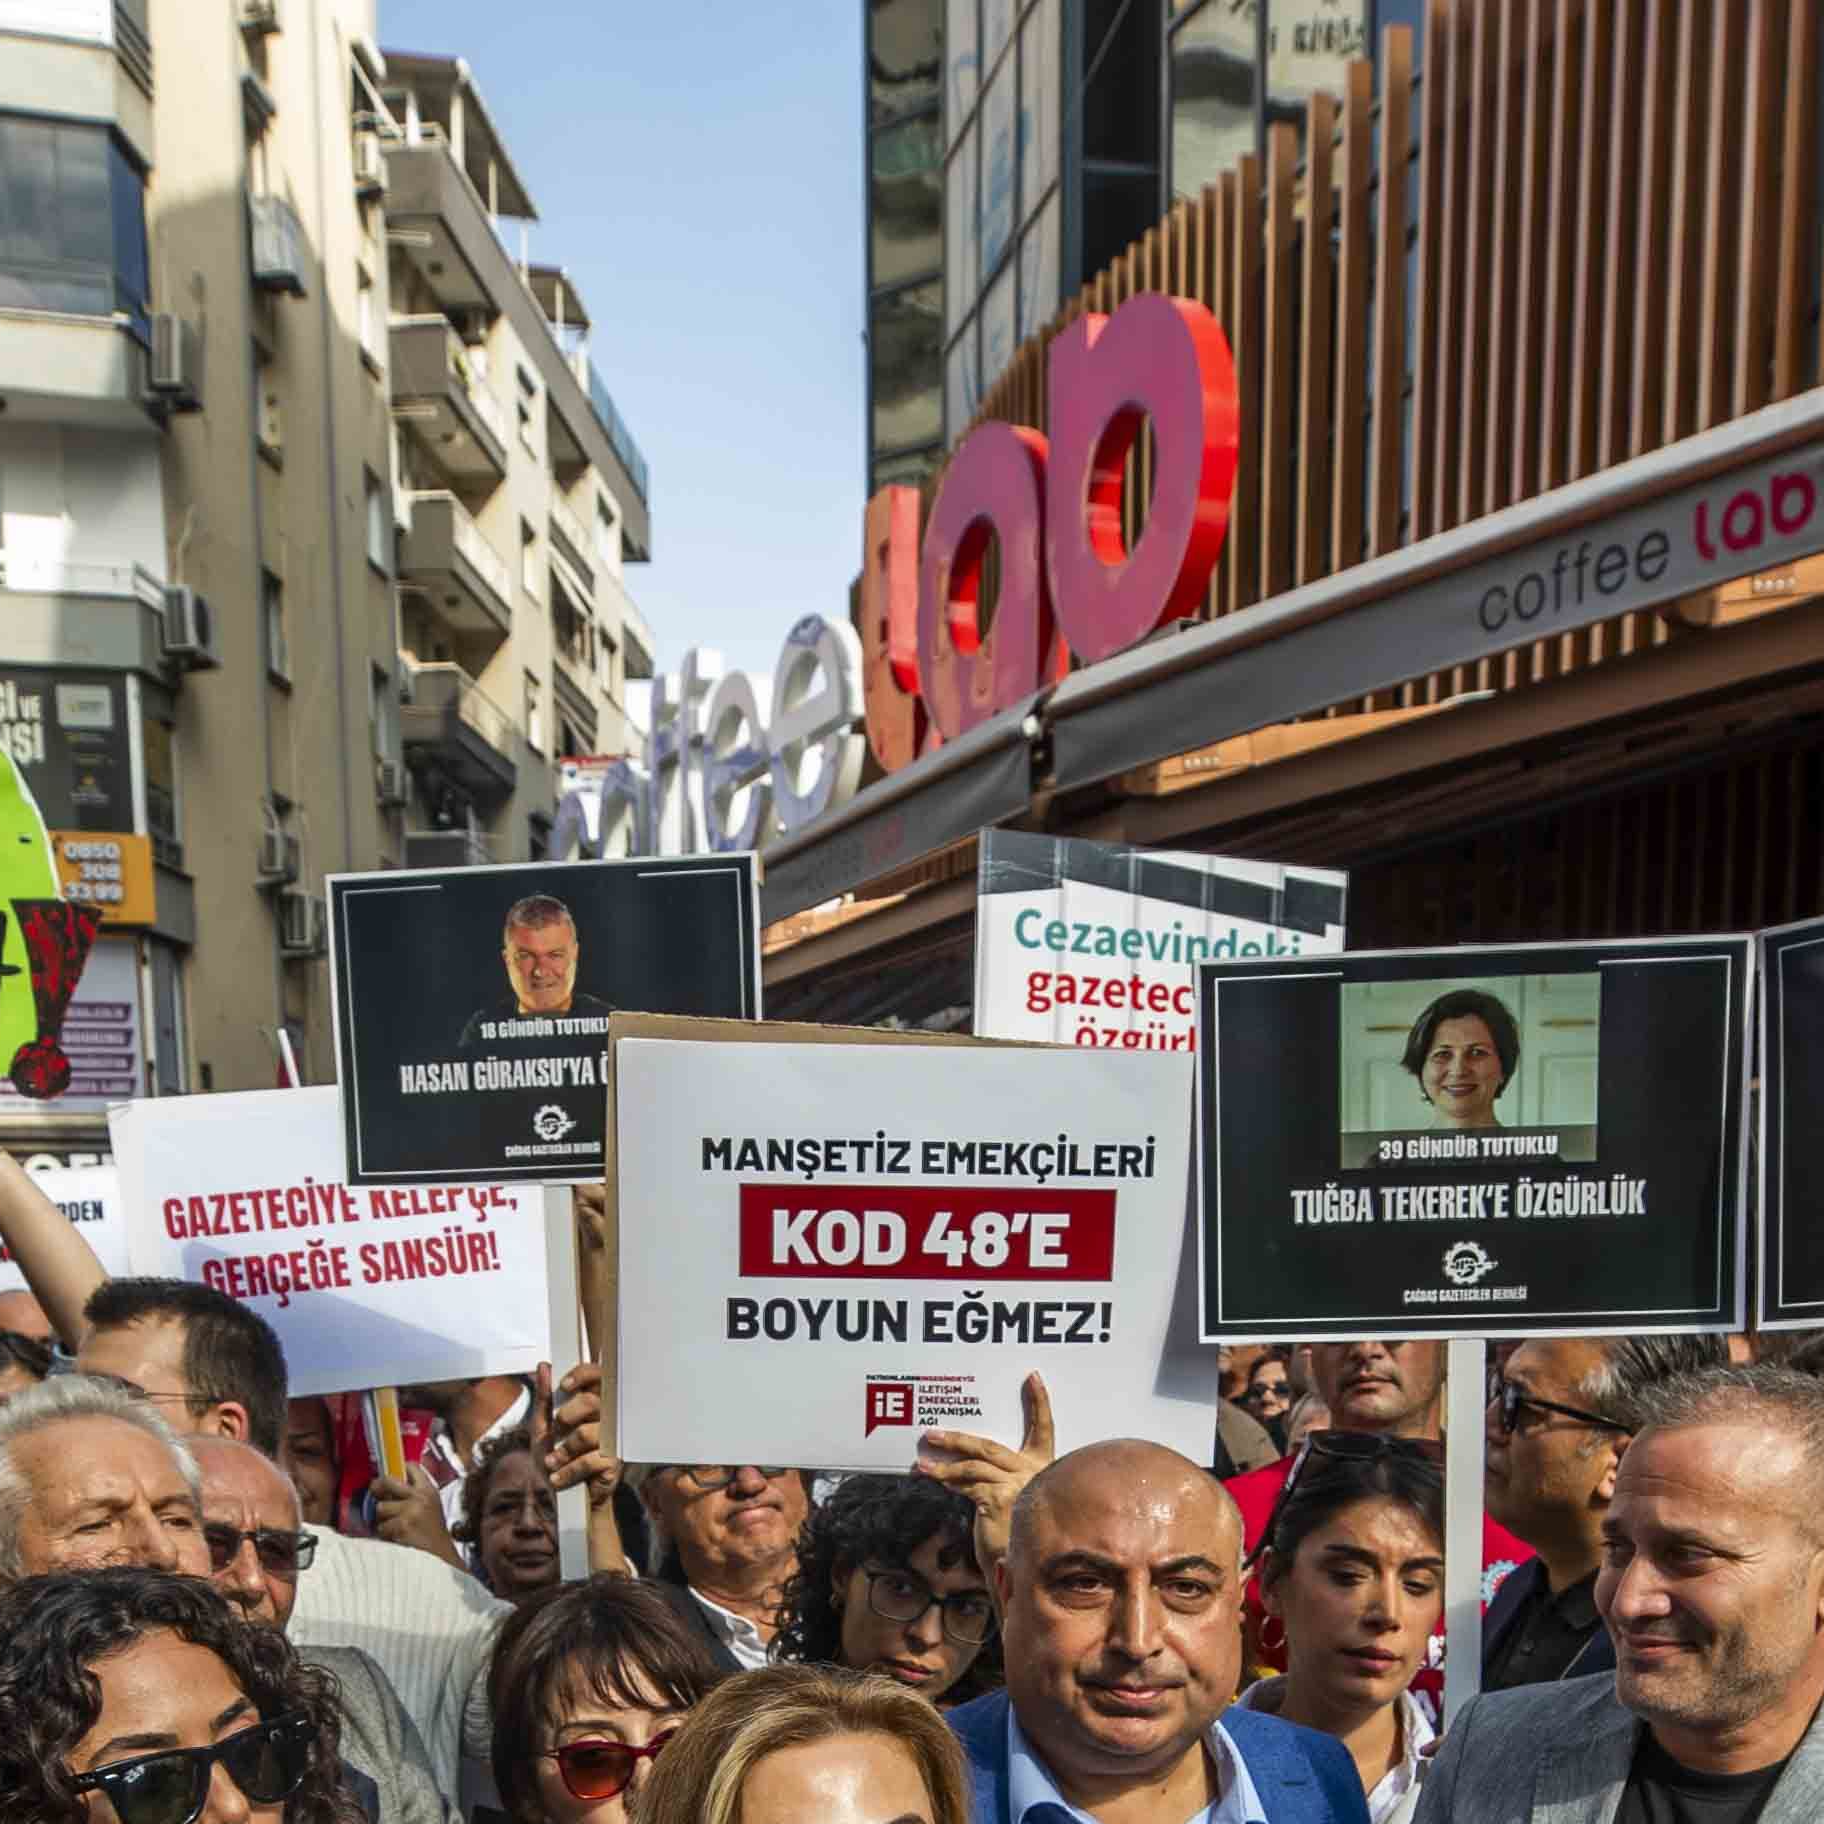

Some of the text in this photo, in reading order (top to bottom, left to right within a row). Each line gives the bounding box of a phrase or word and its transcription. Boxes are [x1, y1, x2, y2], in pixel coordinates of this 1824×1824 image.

[1479, 472, 1816, 632] coffee lab
[1027, 971, 1192, 1018] gazetec
[555, 1016, 608, 1036] TUTUKL
[1076, 1017, 1194, 1050] özgürl
[400, 1062, 470, 1094] HASAN
[474, 1056, 596, 1091] GÜRAKSU'YA
[701, 1130, 1155, 1182] MANŞETİZ EMEKÇİLERİ
[1379, 1132, 1558, 1160] 39 GÜNDÜR TUTUKLU
[164, 1176, 359, 1241] GAZETECİYE
[1291, 1173, 1645, 1224] TUĞBA TEKEREK'E ÖZGÜRLÜK
[772, 1210, 1071, 1269] KOD 48'E
[203, 1227, 501, 1307] GERÇEĞE SANSÜR!
[728, 1290, 1112, 1345] BOYUN EĞMEZ!
